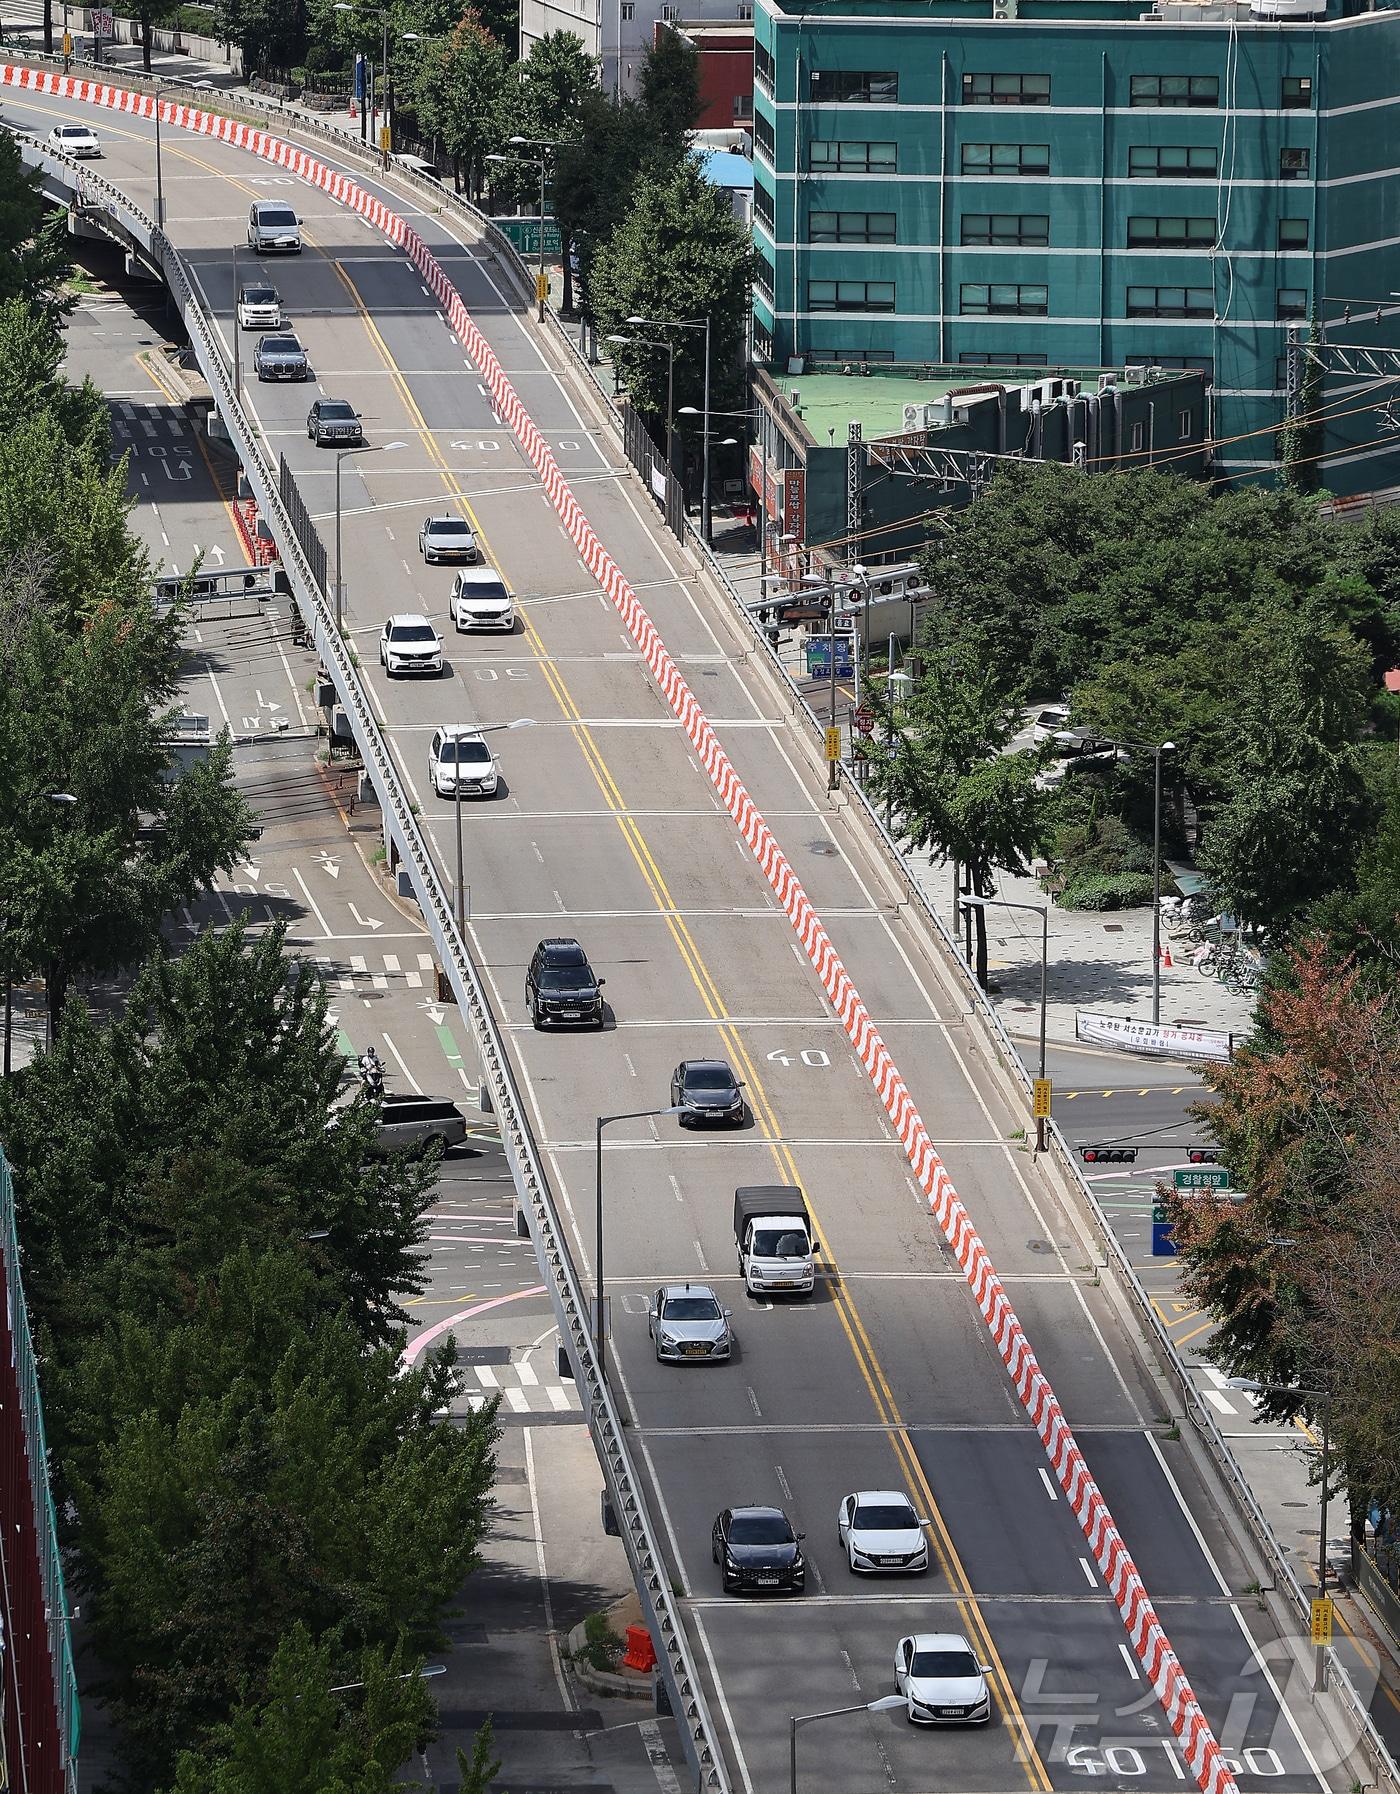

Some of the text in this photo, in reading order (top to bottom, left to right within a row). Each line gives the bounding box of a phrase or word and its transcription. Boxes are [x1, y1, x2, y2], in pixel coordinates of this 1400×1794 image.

[450, 440, 500, 451] 40
[473, 669, 531, 681] 50
[1123, 1025, 1160, 1037] 서소문고가
[1163, 1030, 1177, 1039] 철거
[1181, 1032, 1203, 1042] 공사중
[766, 1049, 831, 1067] 40
[1182, 1174, 1222, 1186] 경찰청앞
[1066, 1747, 1147, 1776] 40
